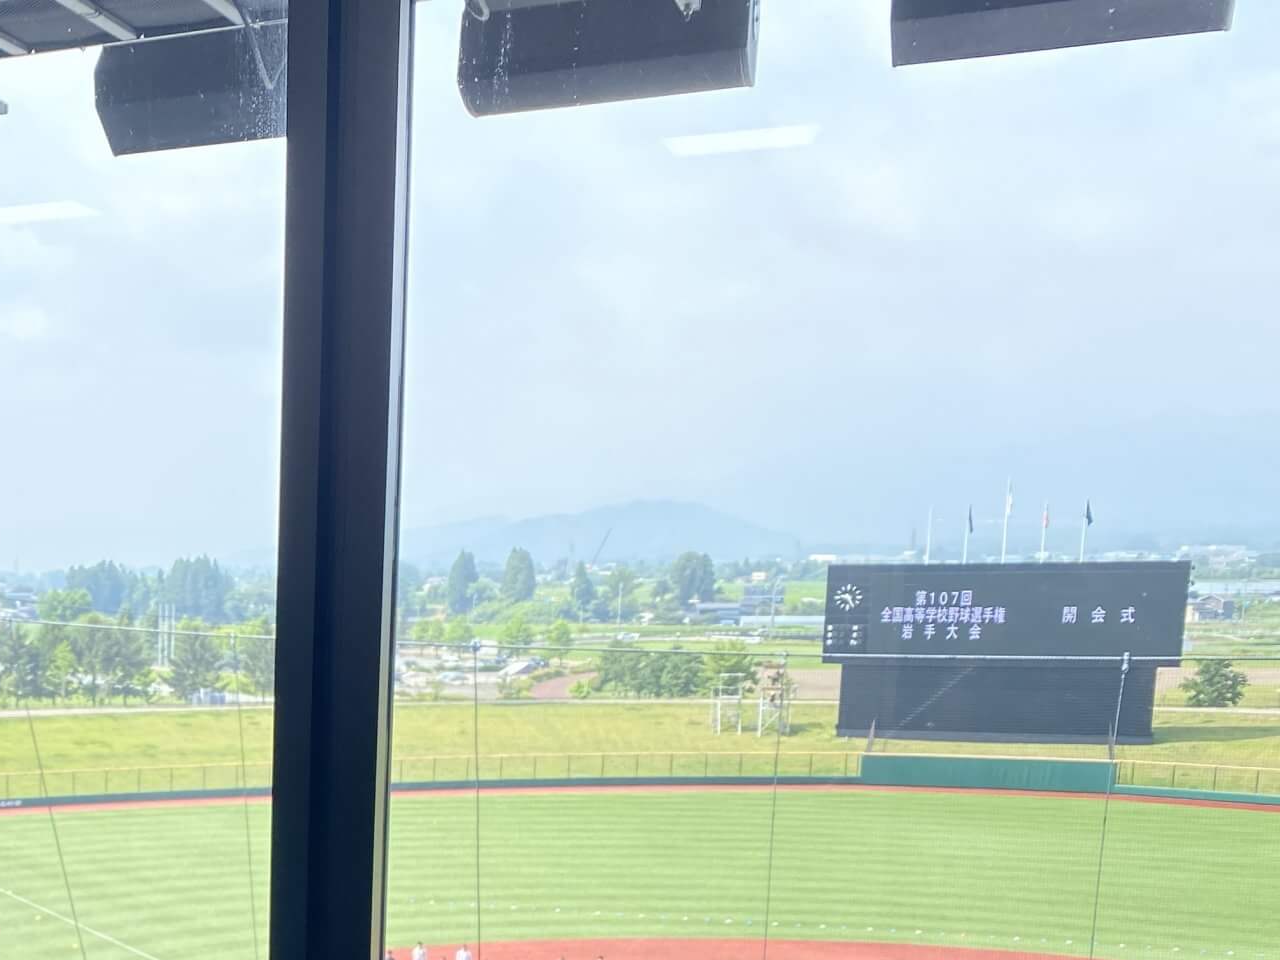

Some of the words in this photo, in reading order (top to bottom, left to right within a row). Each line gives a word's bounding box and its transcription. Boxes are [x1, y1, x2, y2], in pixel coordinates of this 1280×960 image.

[915, 590, 973, 606] 第107回
[880, 606, 1006, 623] 全国高等学校野球選手権
